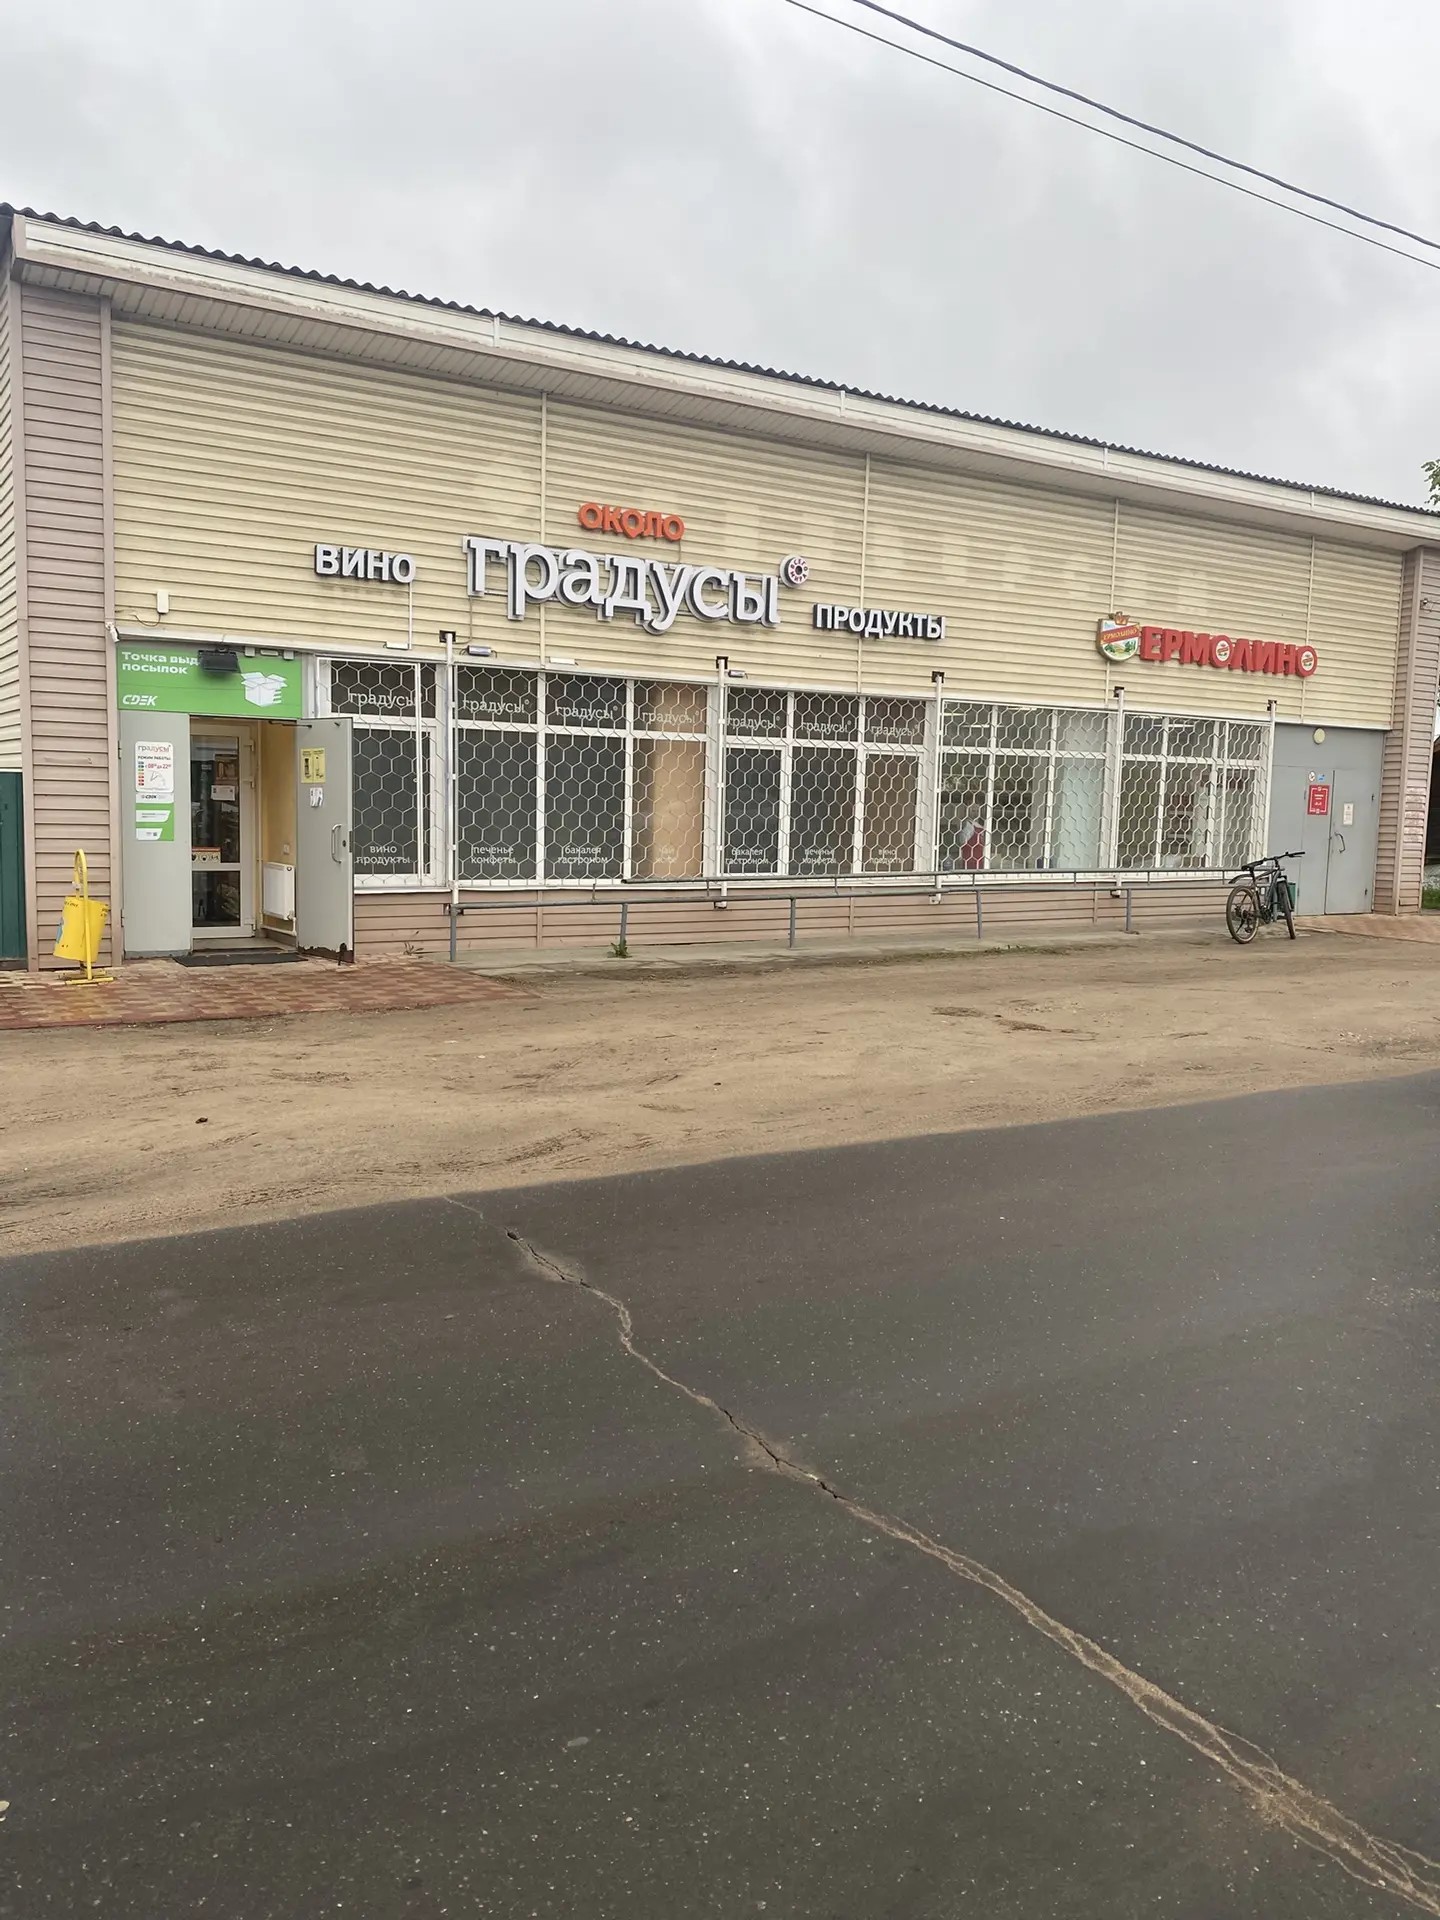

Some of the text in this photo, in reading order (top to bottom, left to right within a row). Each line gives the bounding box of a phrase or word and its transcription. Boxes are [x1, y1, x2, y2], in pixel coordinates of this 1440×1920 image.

[315, 543, 416, 583] ВИНО
[465, 537, 781, 634] градусы
[813, 603, 946, 639] ПРОДУКТЫ
[1140, 626, 1317, 677] ЕРМОЛИНО
[122, 652, 199, 666] Точка выд
[122, 663, 188, 674] посылок
[122, 694, 158, 706] CDEK
[463, 700, 525, 715] градусы
[473, 846, 514, 854] печенье
[356, 857, 410, 865] продукты
